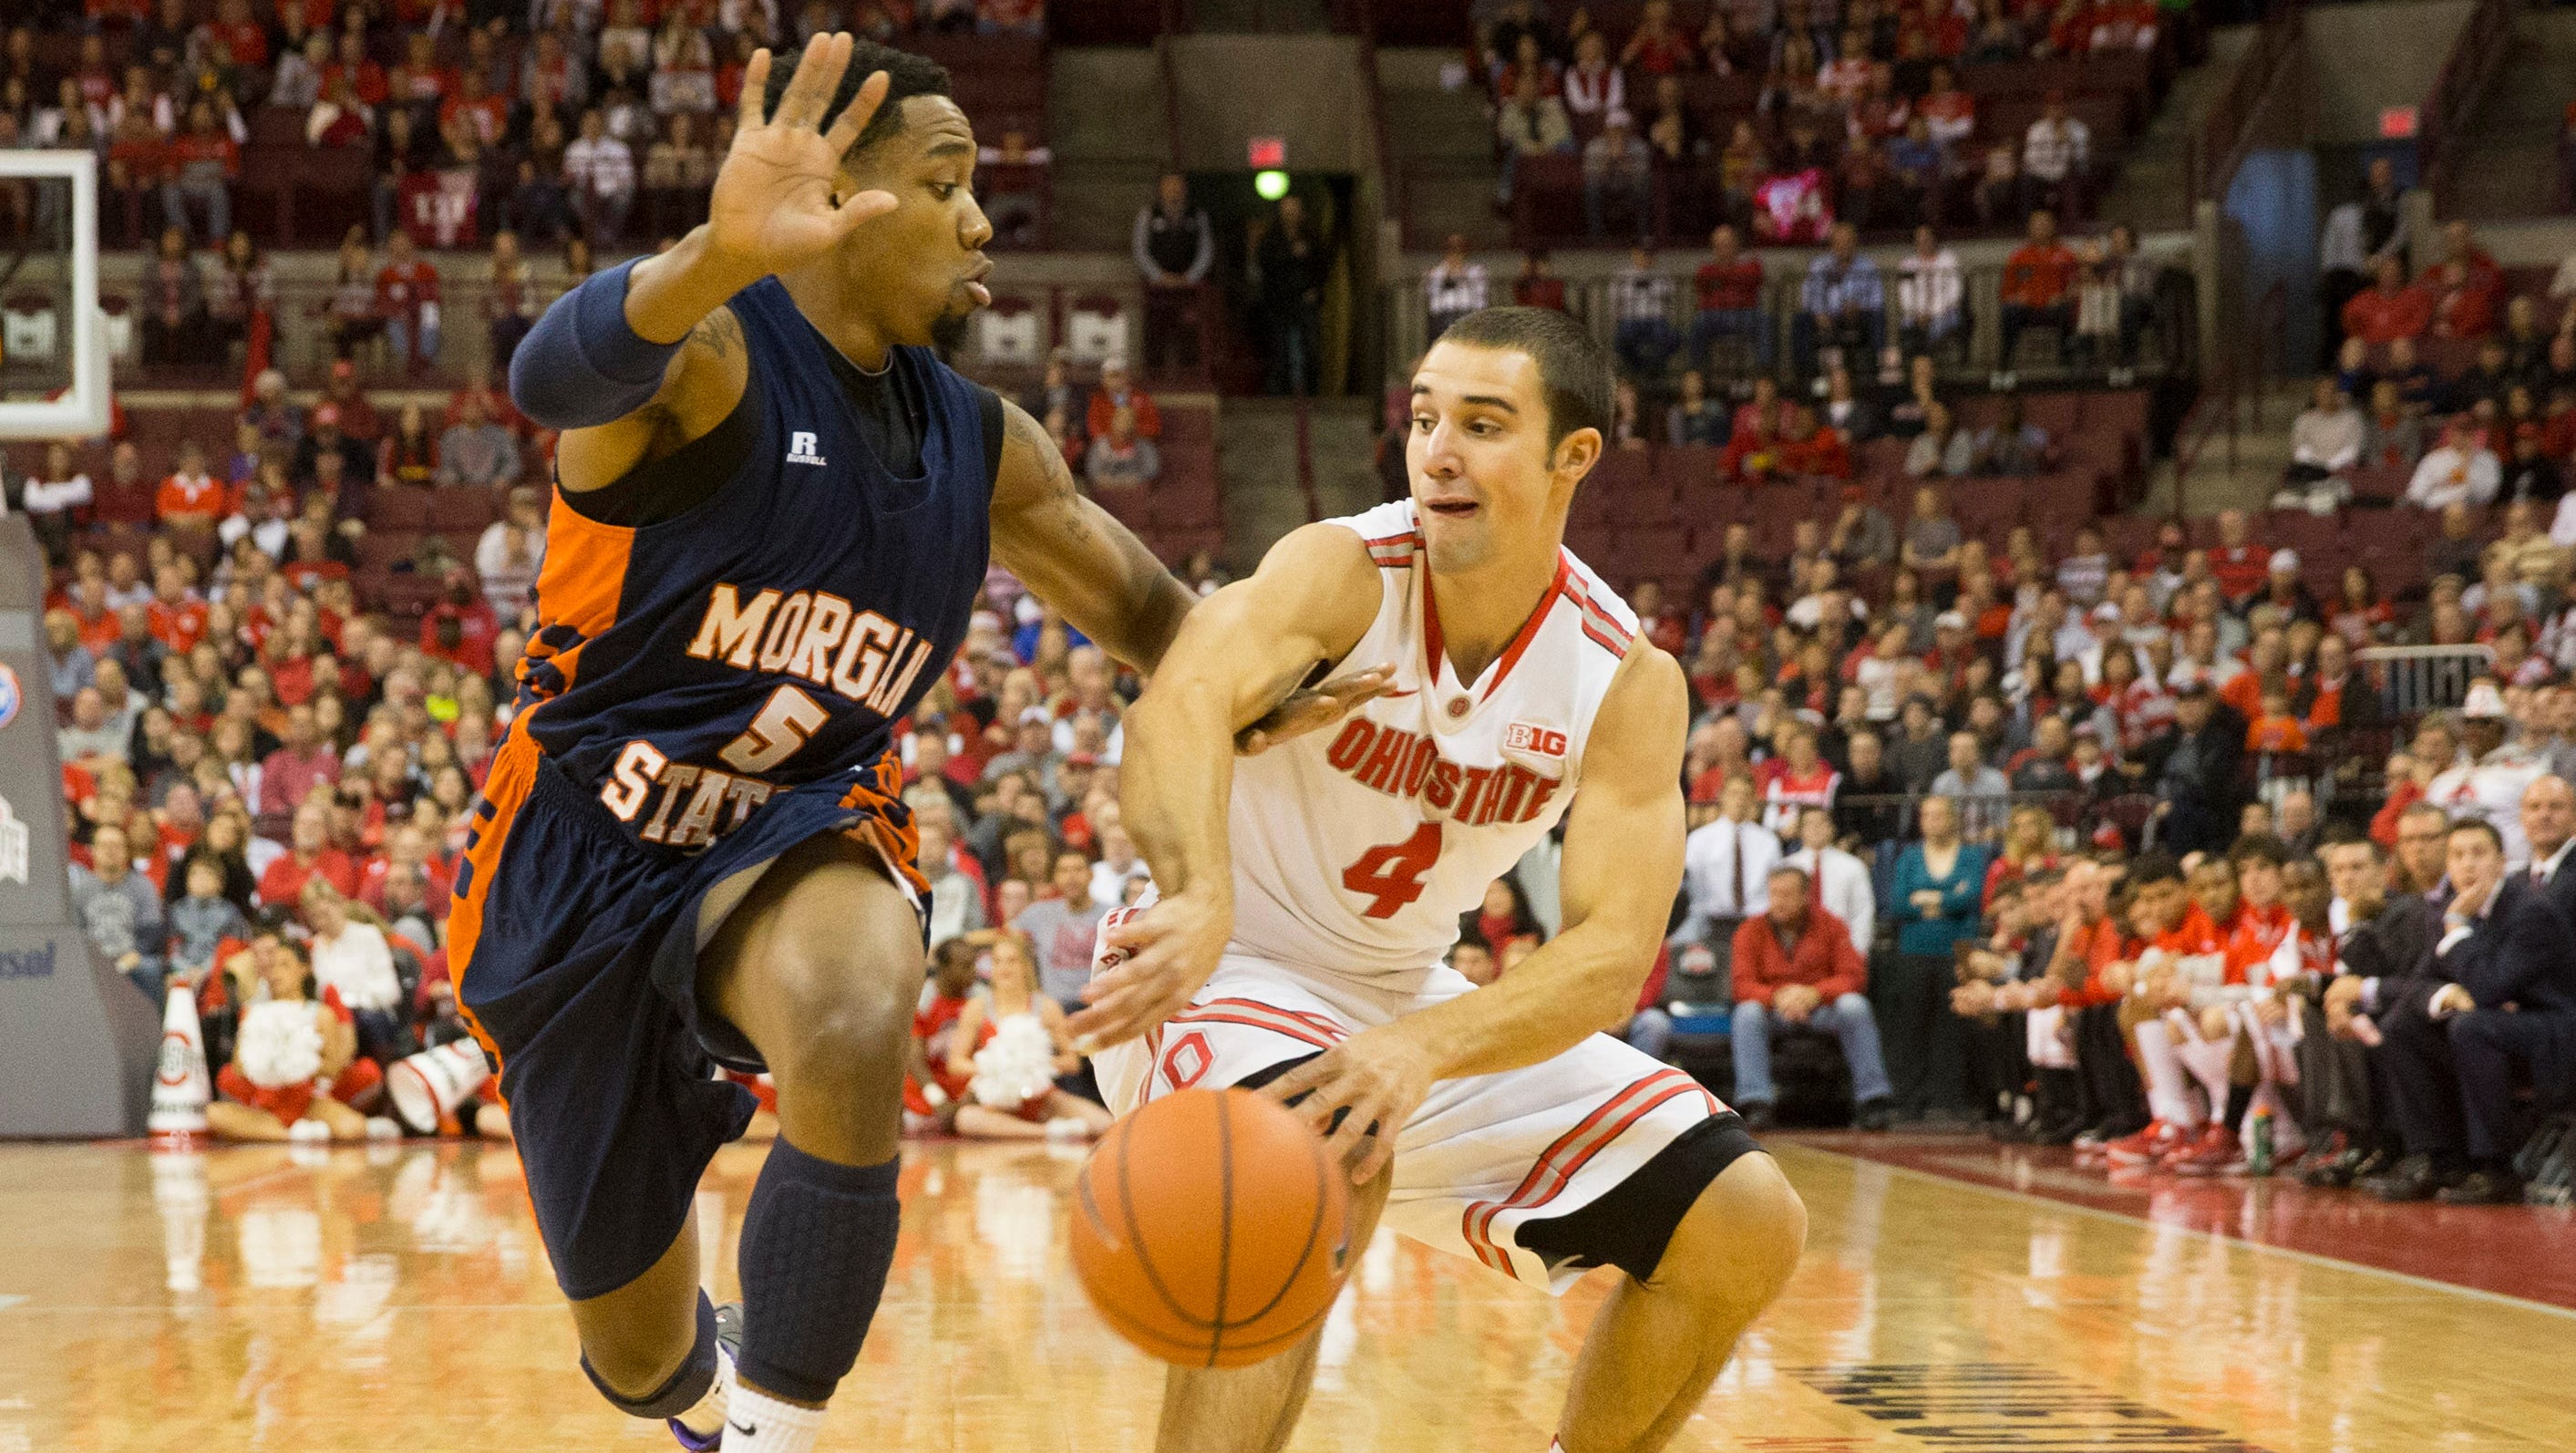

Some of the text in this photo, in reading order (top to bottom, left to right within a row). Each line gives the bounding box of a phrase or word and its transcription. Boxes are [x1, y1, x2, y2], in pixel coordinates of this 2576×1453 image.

[791, 431, 817, 456] R
[717, 683, 831, 773] 5
[1326, 715, 1562, 827] OHIO STATE
[600, 739, 796, 845] STAT
[1342, 821, 1442, 919] 4
